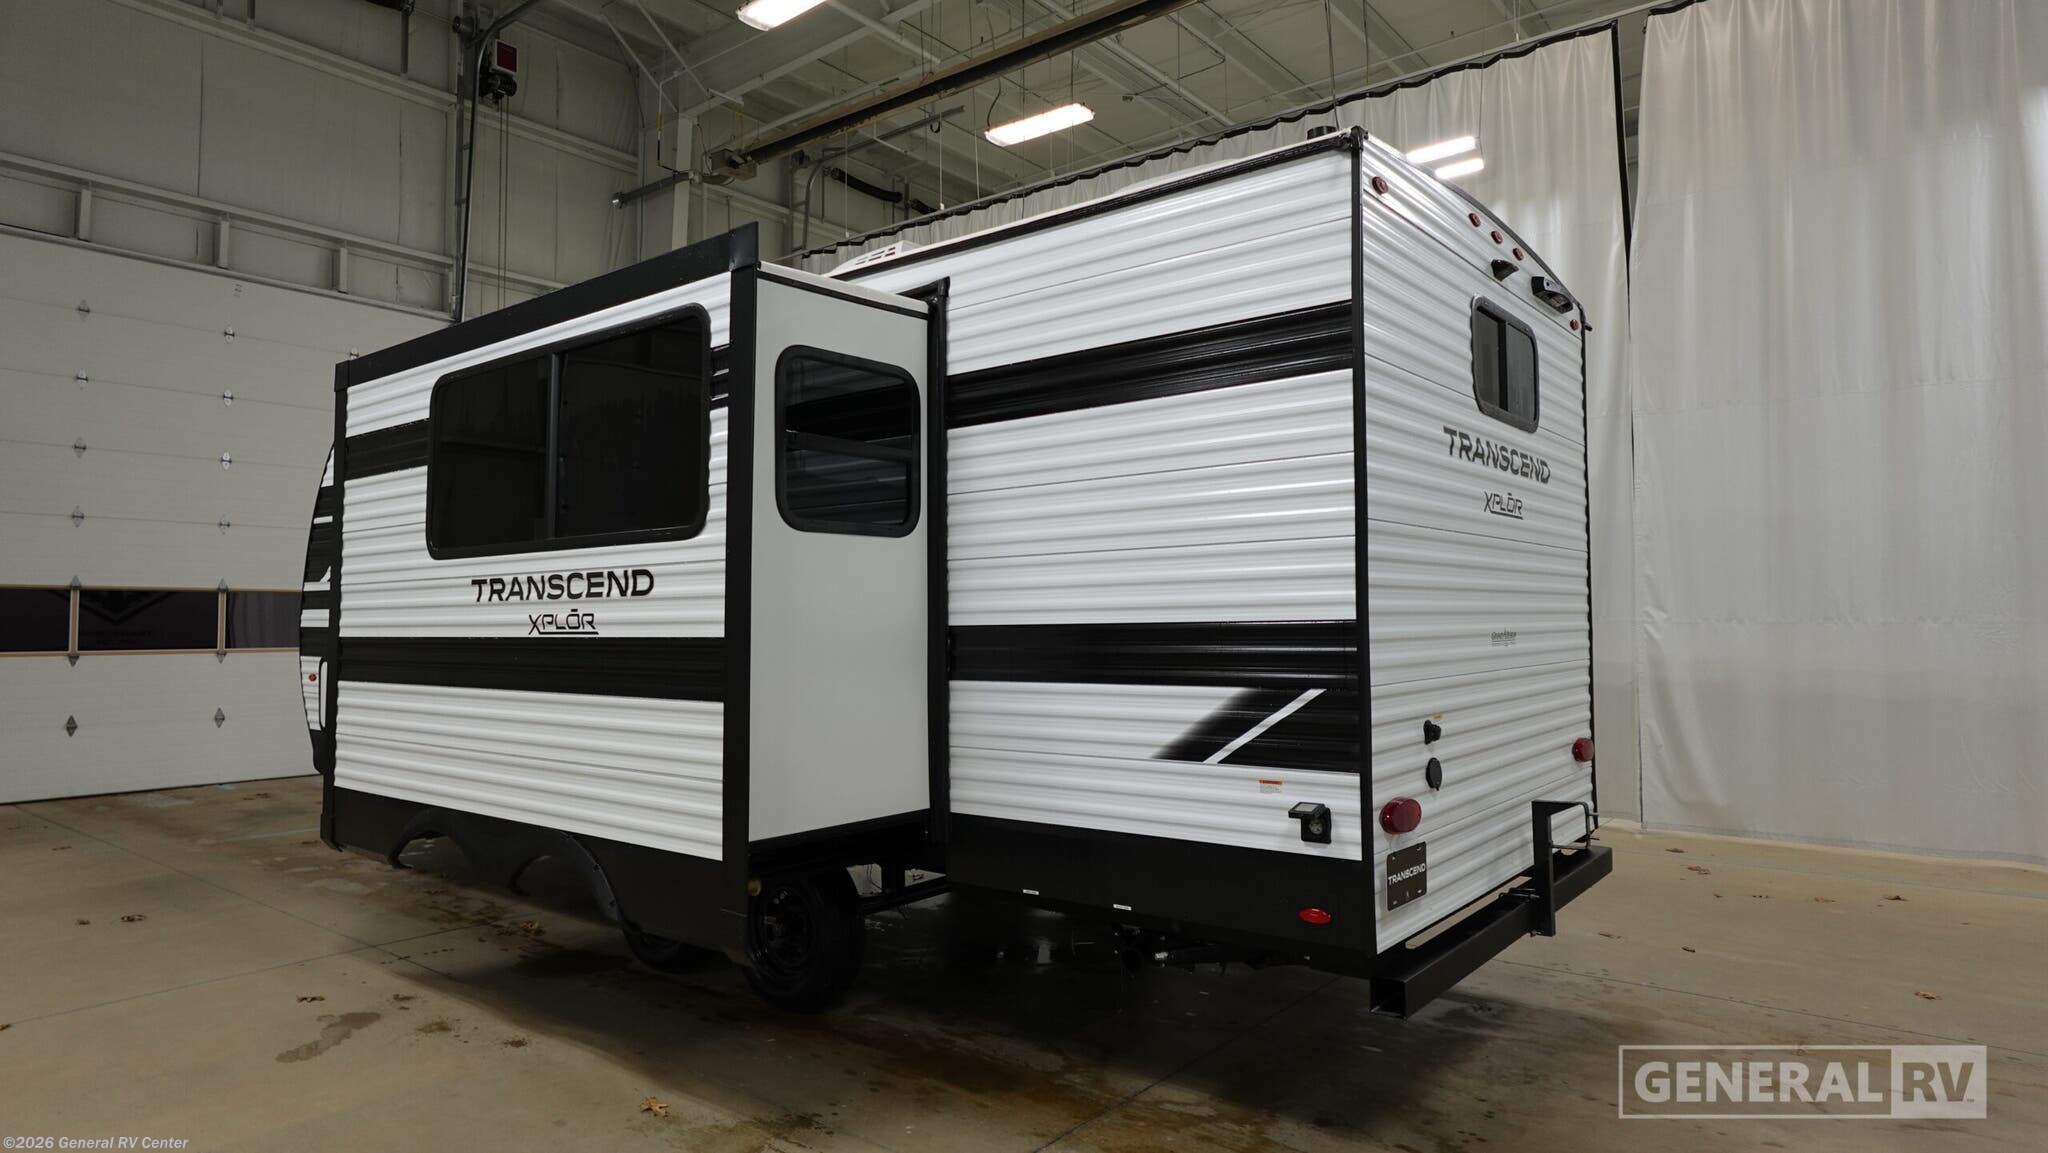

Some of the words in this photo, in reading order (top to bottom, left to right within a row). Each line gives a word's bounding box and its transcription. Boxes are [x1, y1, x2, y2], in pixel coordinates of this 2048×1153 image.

[1443, 425, 1551, 484] TRANSCEND
[471, 569, 655, 602] TRANSCEND
[1388, 863, 1426, 886] TRANSCEND
